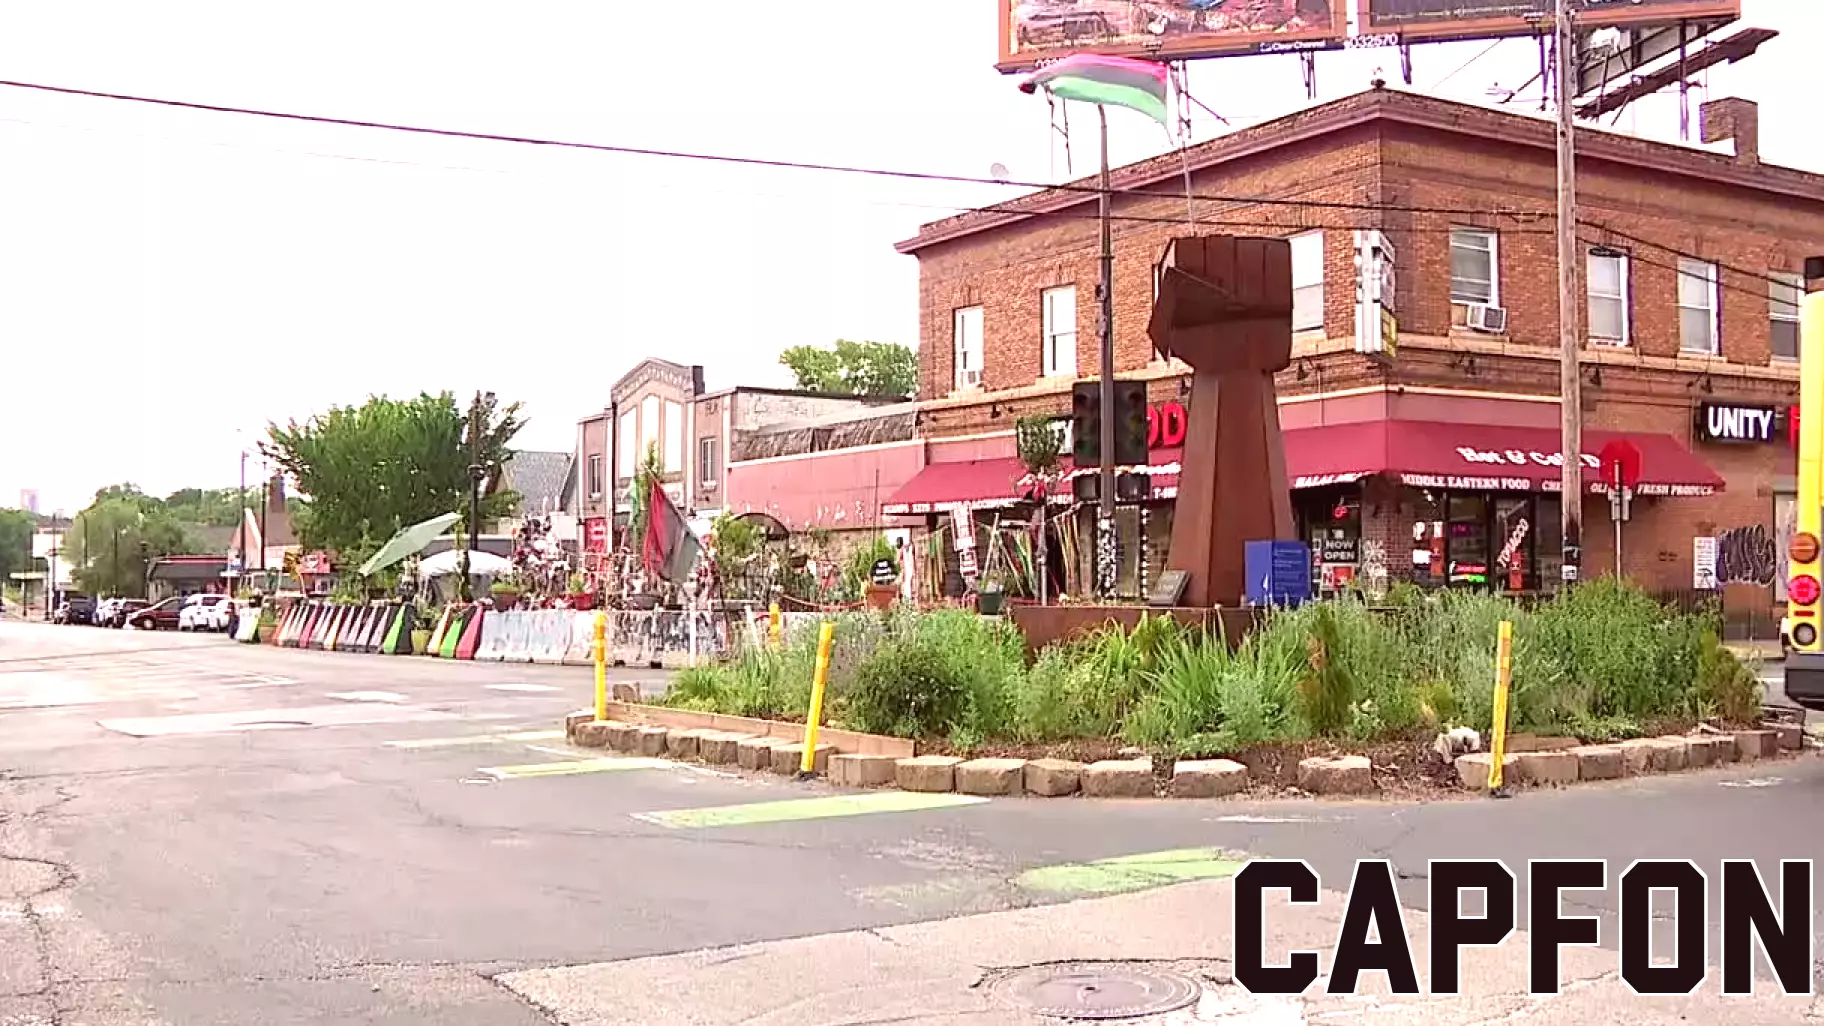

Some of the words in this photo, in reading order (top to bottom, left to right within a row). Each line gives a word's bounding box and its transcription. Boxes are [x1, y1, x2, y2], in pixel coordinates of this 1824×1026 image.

[1707, 405, 1773, 439] UNITY
[1401, 473, 1446, 487] MIDDLE
[1448, 476, 1499, 489] EASTERN
[1502, 478, 1530, 490] FOOD
[1637, 483, 1669, 495] FRESH
[1324, 551, 1355, 560] OPEN
